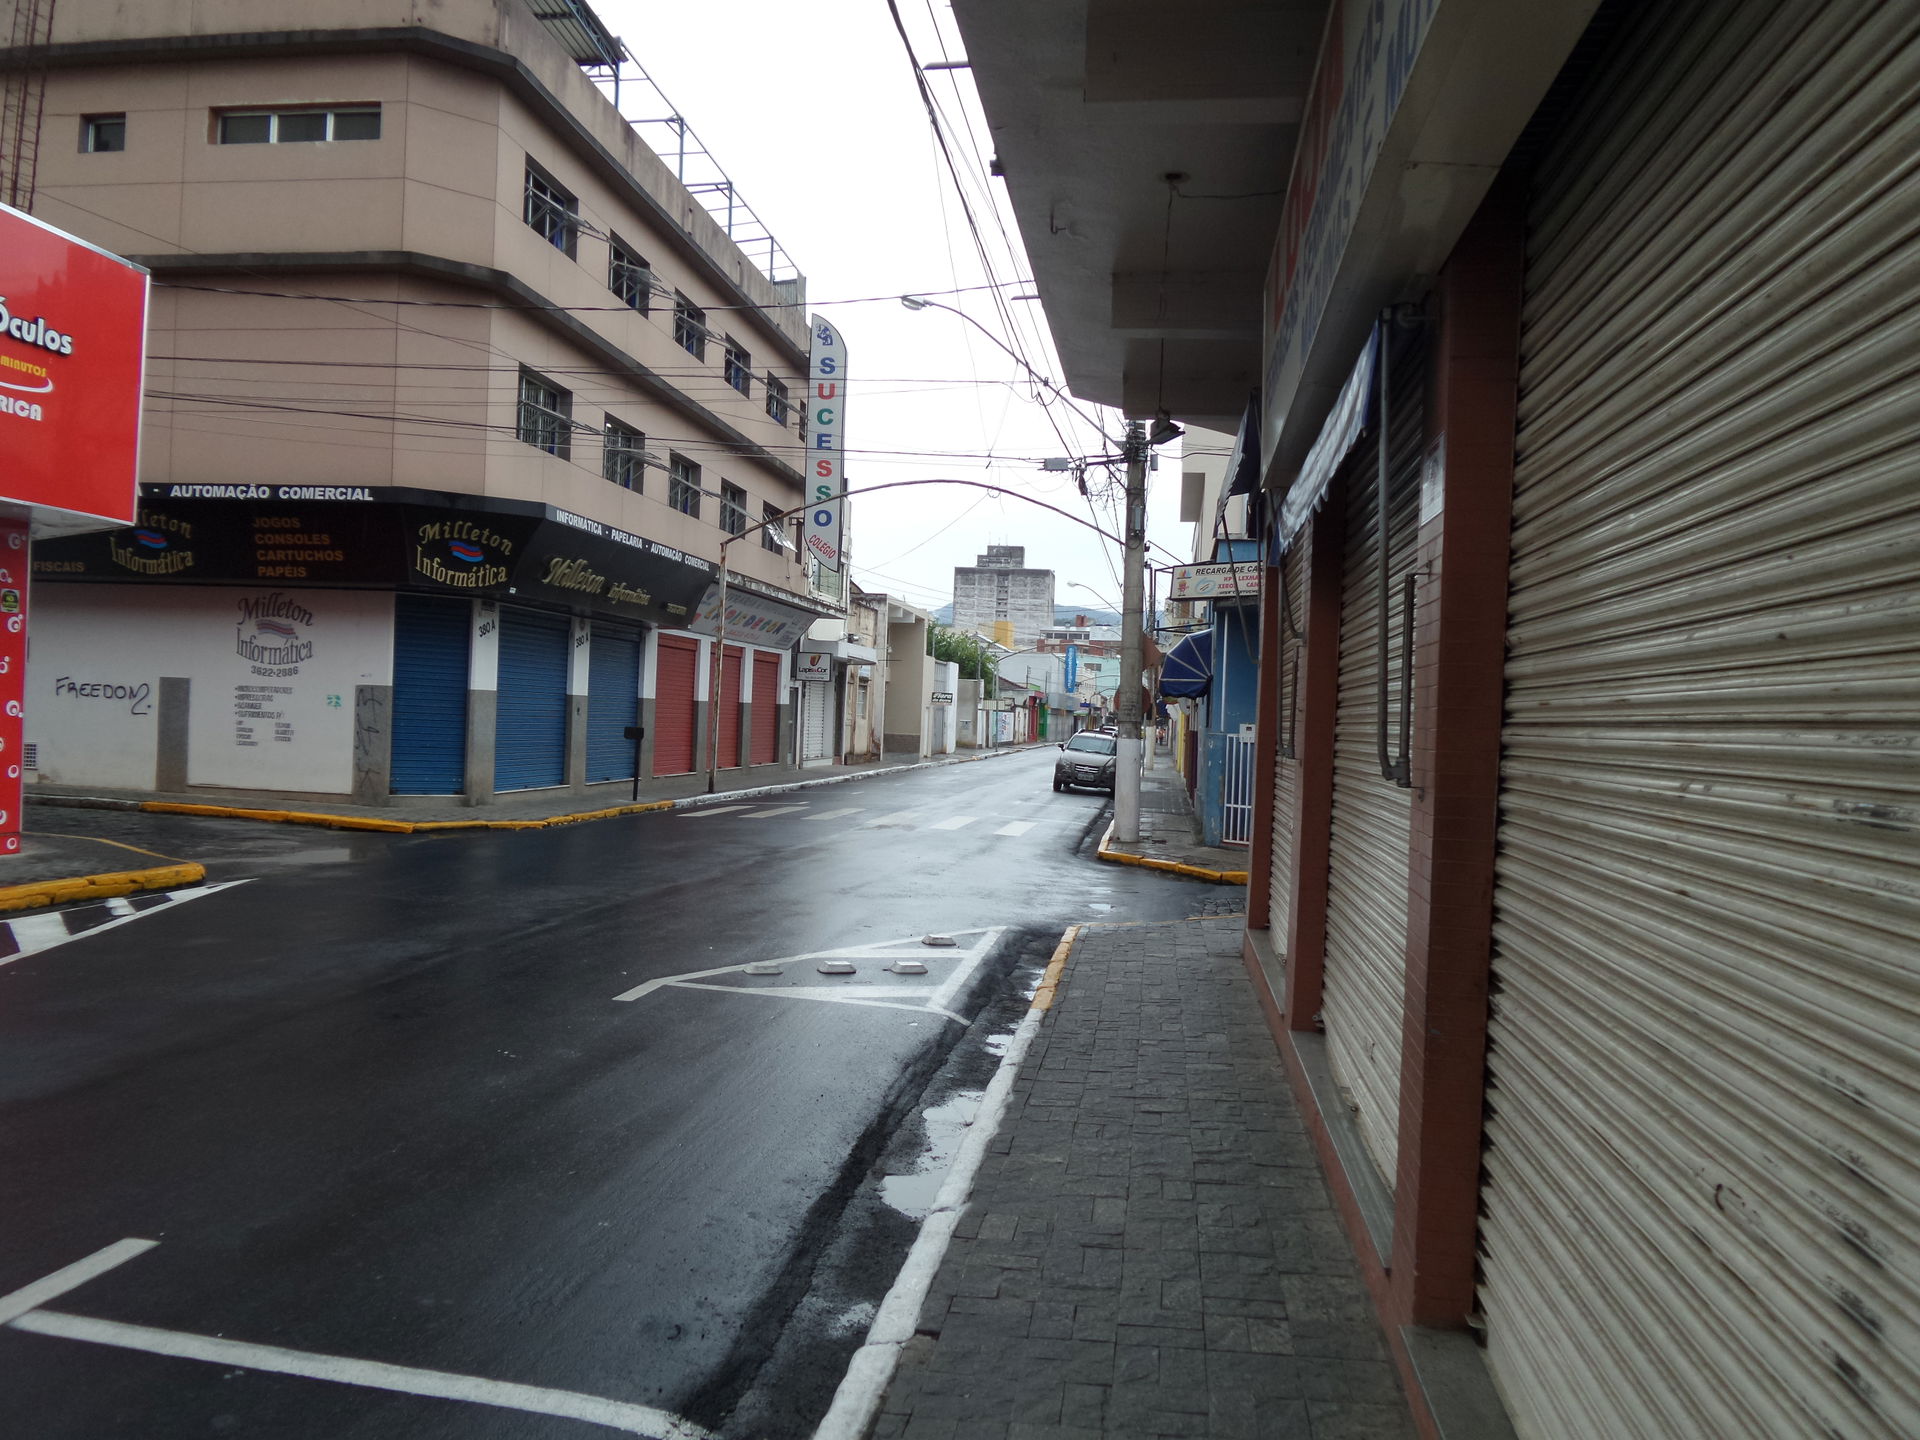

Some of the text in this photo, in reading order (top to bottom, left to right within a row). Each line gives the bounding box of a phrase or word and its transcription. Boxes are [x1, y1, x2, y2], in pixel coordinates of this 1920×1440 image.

[813, 356, 836, 527] SUCESSO
[170, 483, 270, 499] AUTOMAÇÃO
[278, 487, 374, 501] COMERCIAL
[136, 508, 193, 539] lleton
[253, 517, 301, 529] JOGOS
[418, 521, 513, 556] Milleton
[254, 533, 331, 545] CONSOLES
[556, 510, 602, 536] INFORMÁTICA
[611, 529, 643, 549] PAPELARIA
[650, 543, 682, 562] AUTOMAÇÃO
[684, 554, 710, 571] COMERCIAL
[808, 534, 837, 559] COLÉGIO
[33, 561, 85, 573] FISCAIS
[109, 536, 194, 575] Informática
[256, 550, 344, 562] CARTUCHOS
[257, 564, 306, 578] PAPÉIS
[415, 545, 509, 588] Informática
[1195, 566, 1233, 576] RECARGA
[542, 557, 606, 593] Milleton
[237, 592, 313, 627] Milleton
[236, 627, 313, 666] Informática
